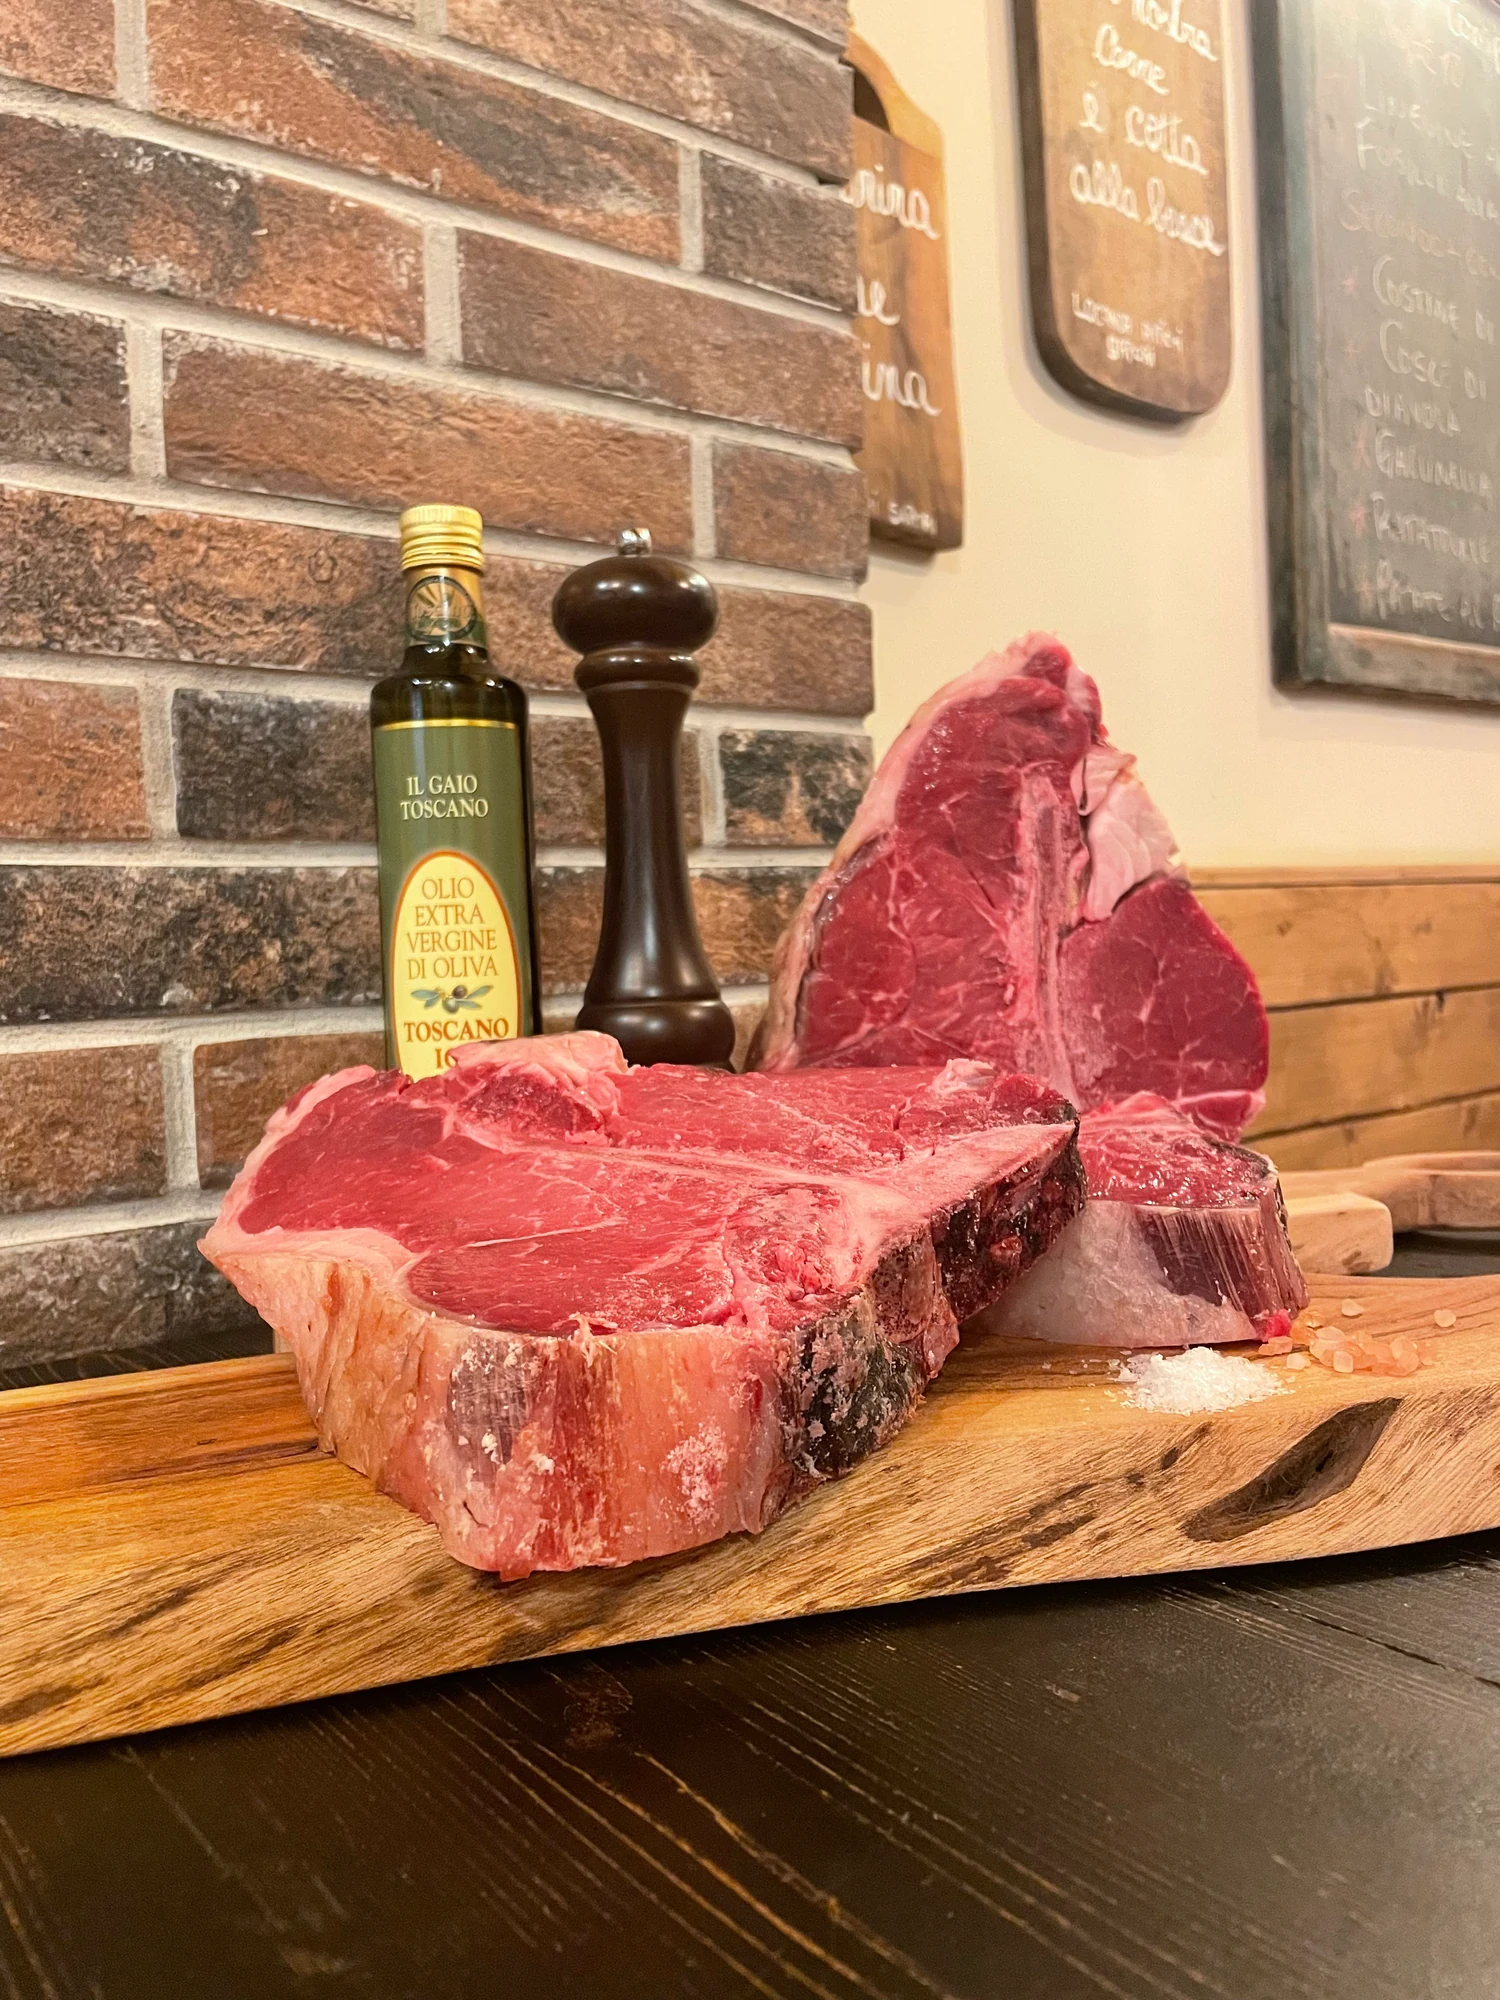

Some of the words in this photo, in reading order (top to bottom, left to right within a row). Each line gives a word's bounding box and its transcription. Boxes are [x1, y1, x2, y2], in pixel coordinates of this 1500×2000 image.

[1125, 105, 1208, 176] cotta
[1070, 160, 1141, 221] alla
[406, 776, 424, 796] IL
[428, 774, 478, 795] GAIO
[400, 798, 489, 820] TOSCANO
[421, 877, 475, 900] OLIO
[415, 903, 485, 927] EXTRA
[406, 929, 498, 953] VERGINE
[408, 958, 426, 980] DI
[433, 955, 499, 979] OLIVA
[404, 1018, 509, 1043] TOSCANO
